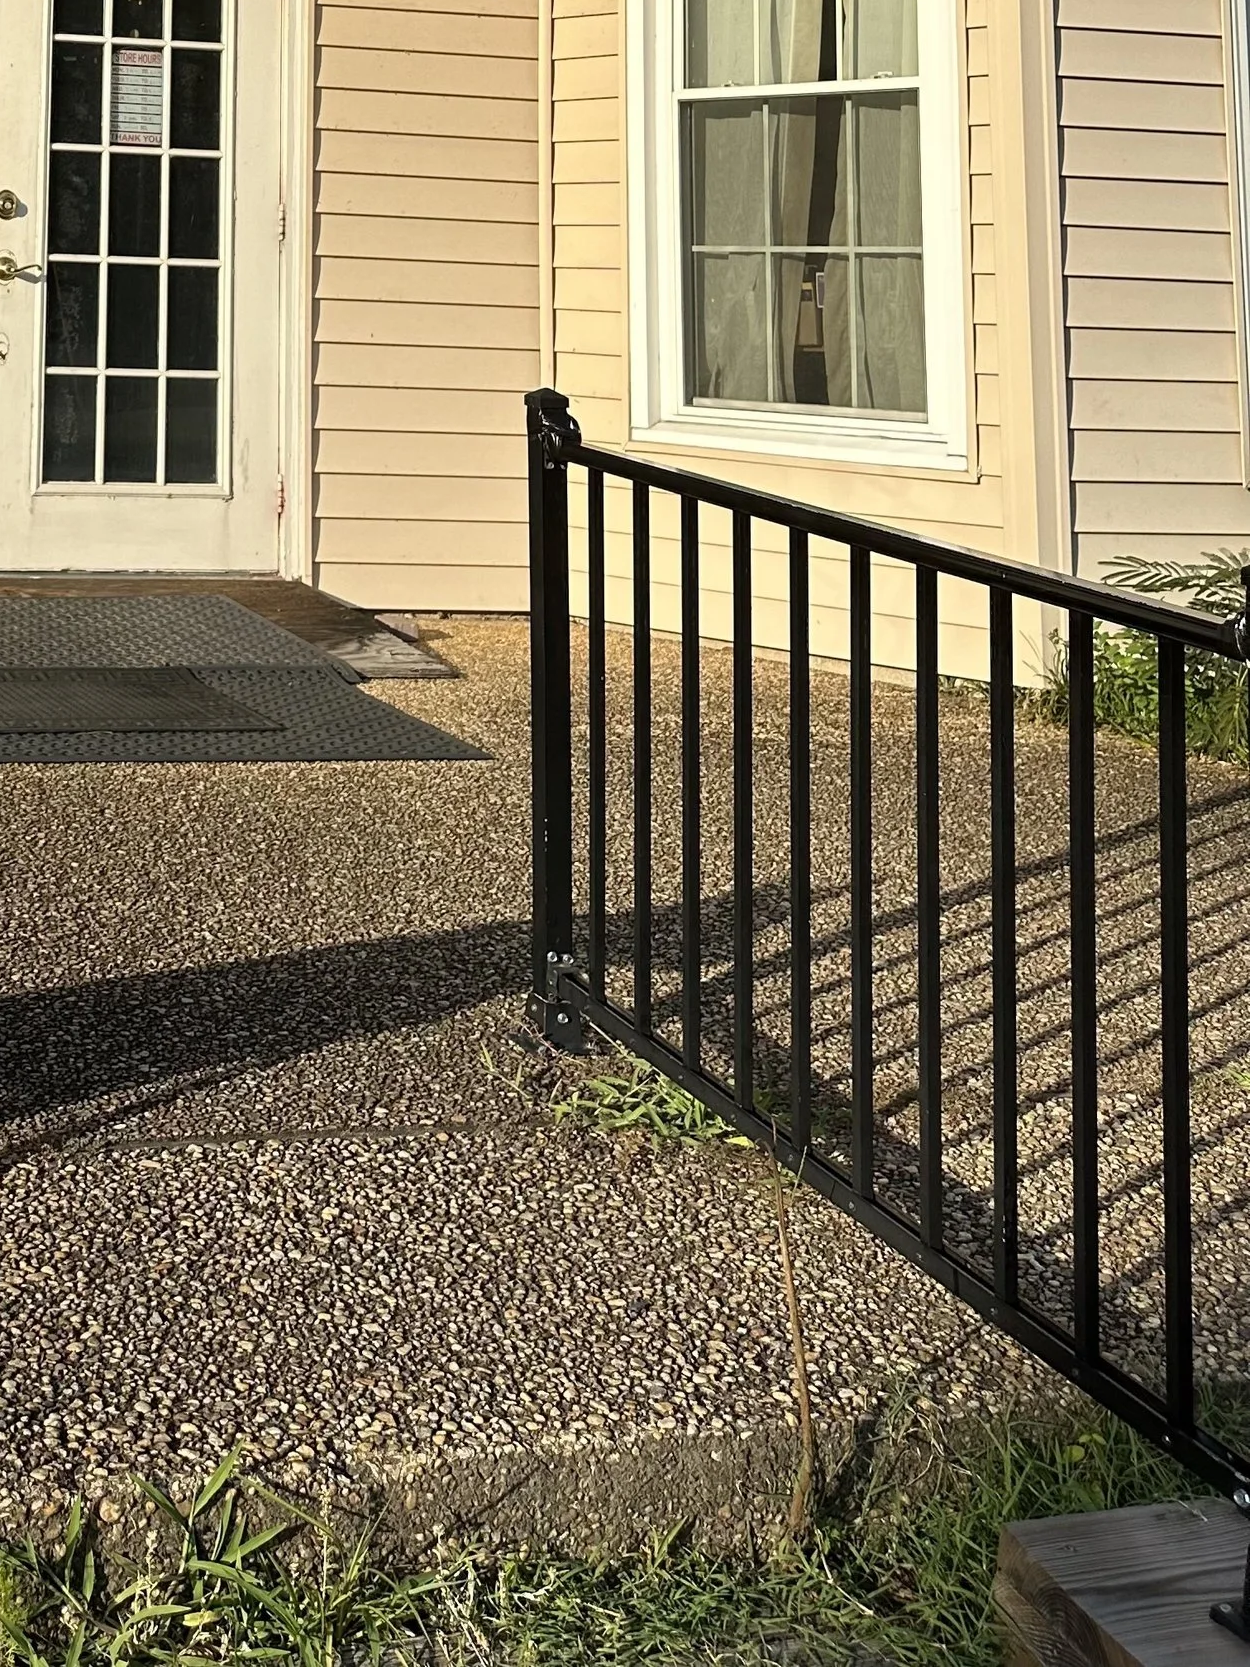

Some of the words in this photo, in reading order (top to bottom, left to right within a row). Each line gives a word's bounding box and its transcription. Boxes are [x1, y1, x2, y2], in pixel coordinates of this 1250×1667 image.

[114, 52, 137, 63] STORE
[138, 53, 162, 65] HOURS
[111, 133, 141, 144] THANK
[143, 134, 162, 144] YOU
